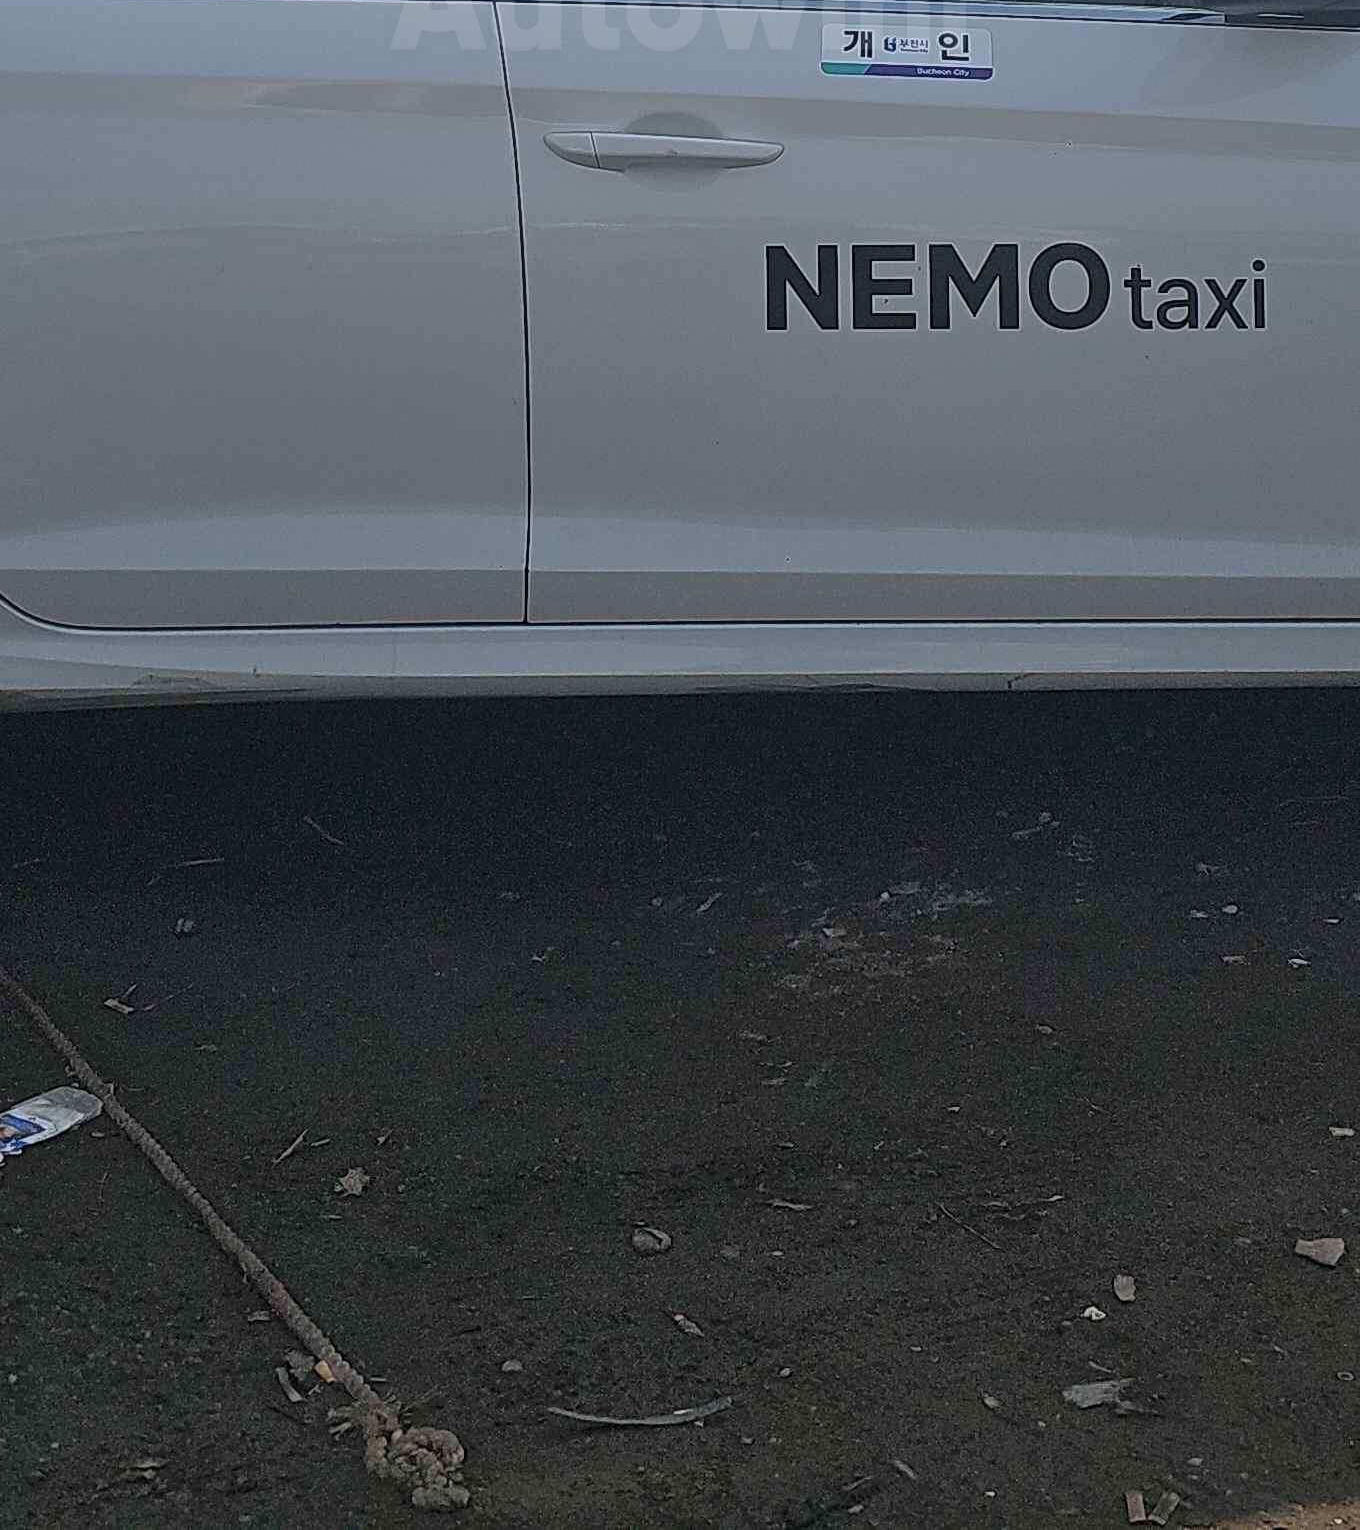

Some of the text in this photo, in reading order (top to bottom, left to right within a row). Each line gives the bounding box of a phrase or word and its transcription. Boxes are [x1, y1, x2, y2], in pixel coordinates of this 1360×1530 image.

[916, 67, 970, 78] Bucheon City
[765, 242, 1266, 331] NEMO taxi
